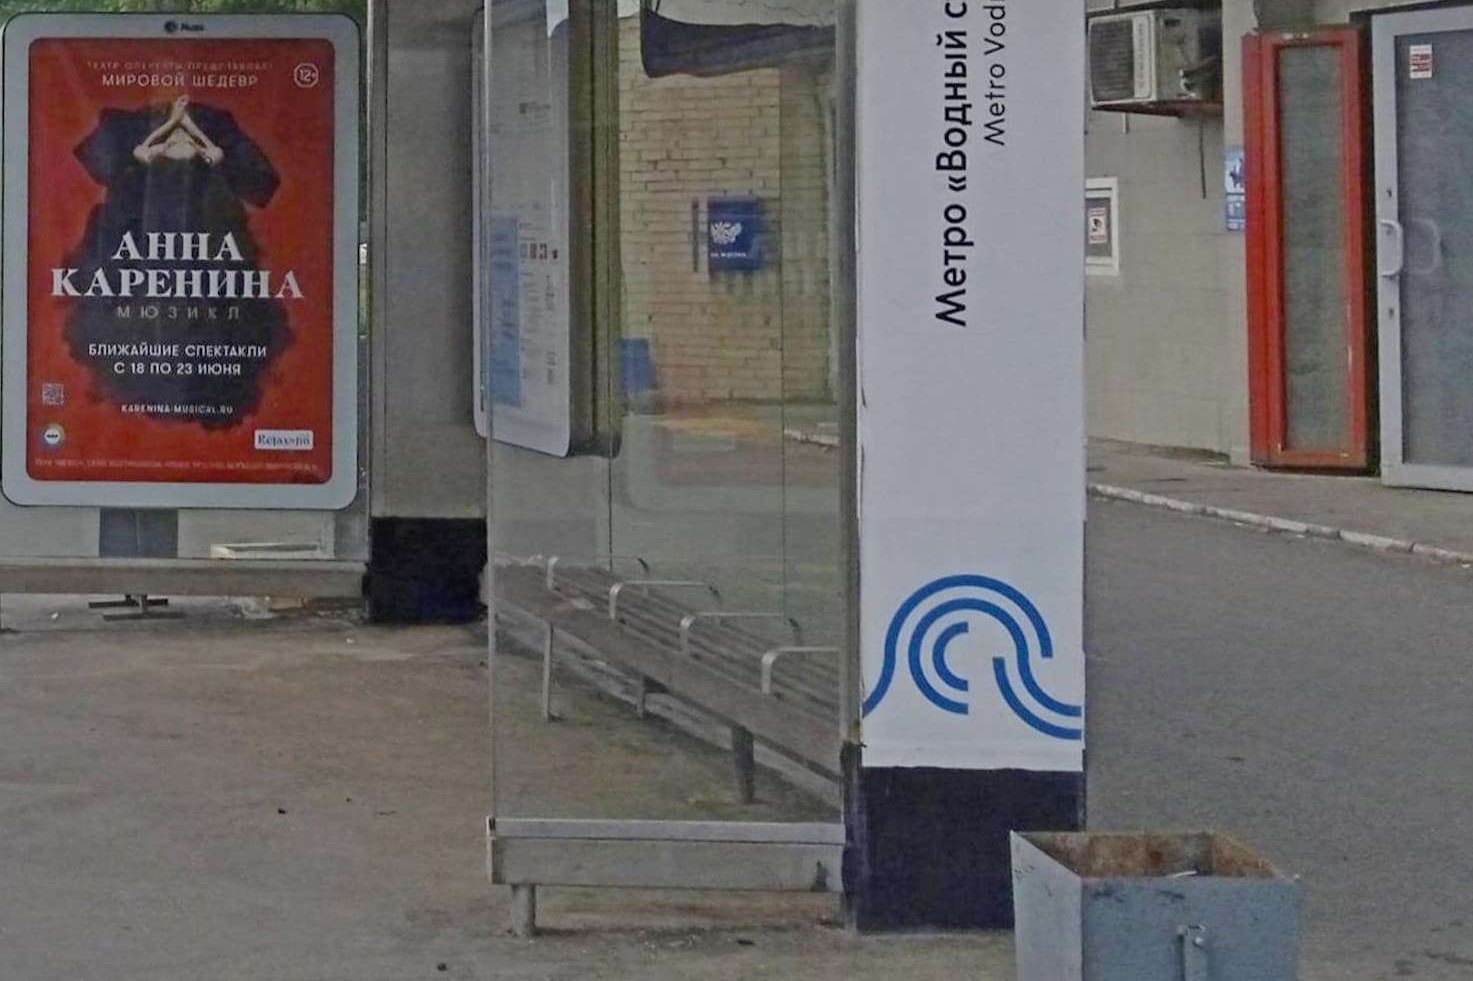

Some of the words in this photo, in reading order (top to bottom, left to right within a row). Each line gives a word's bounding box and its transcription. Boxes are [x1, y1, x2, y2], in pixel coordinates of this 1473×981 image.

[101, 72, 185, 87] МИРОВОЙ
[192, 74, 259, 88] ШЕДЕВР
[935, 29, 973, 194] «Водный
[983, 63, 1007, 146] Metro
[111, 229, 244, 261] АННА
[935, 202, 975, 327] Метро
[50, 267, 305, 299] КАРЕНИНА
[116, 305, 241, 320] МЮЗИКЛ
[88, 341, 180, 357] БЛИЖАЙШИЕ
[184, 344, 267, 358] СПЕКТАКЛИ
[113, 362, 125, 374] С
[130, 362, 145, 374] 18
[150, 362, 172, 374] ПО
[176, 362, 193, 374] 23
[197, 363, 242, 375] ИЮНЯ
